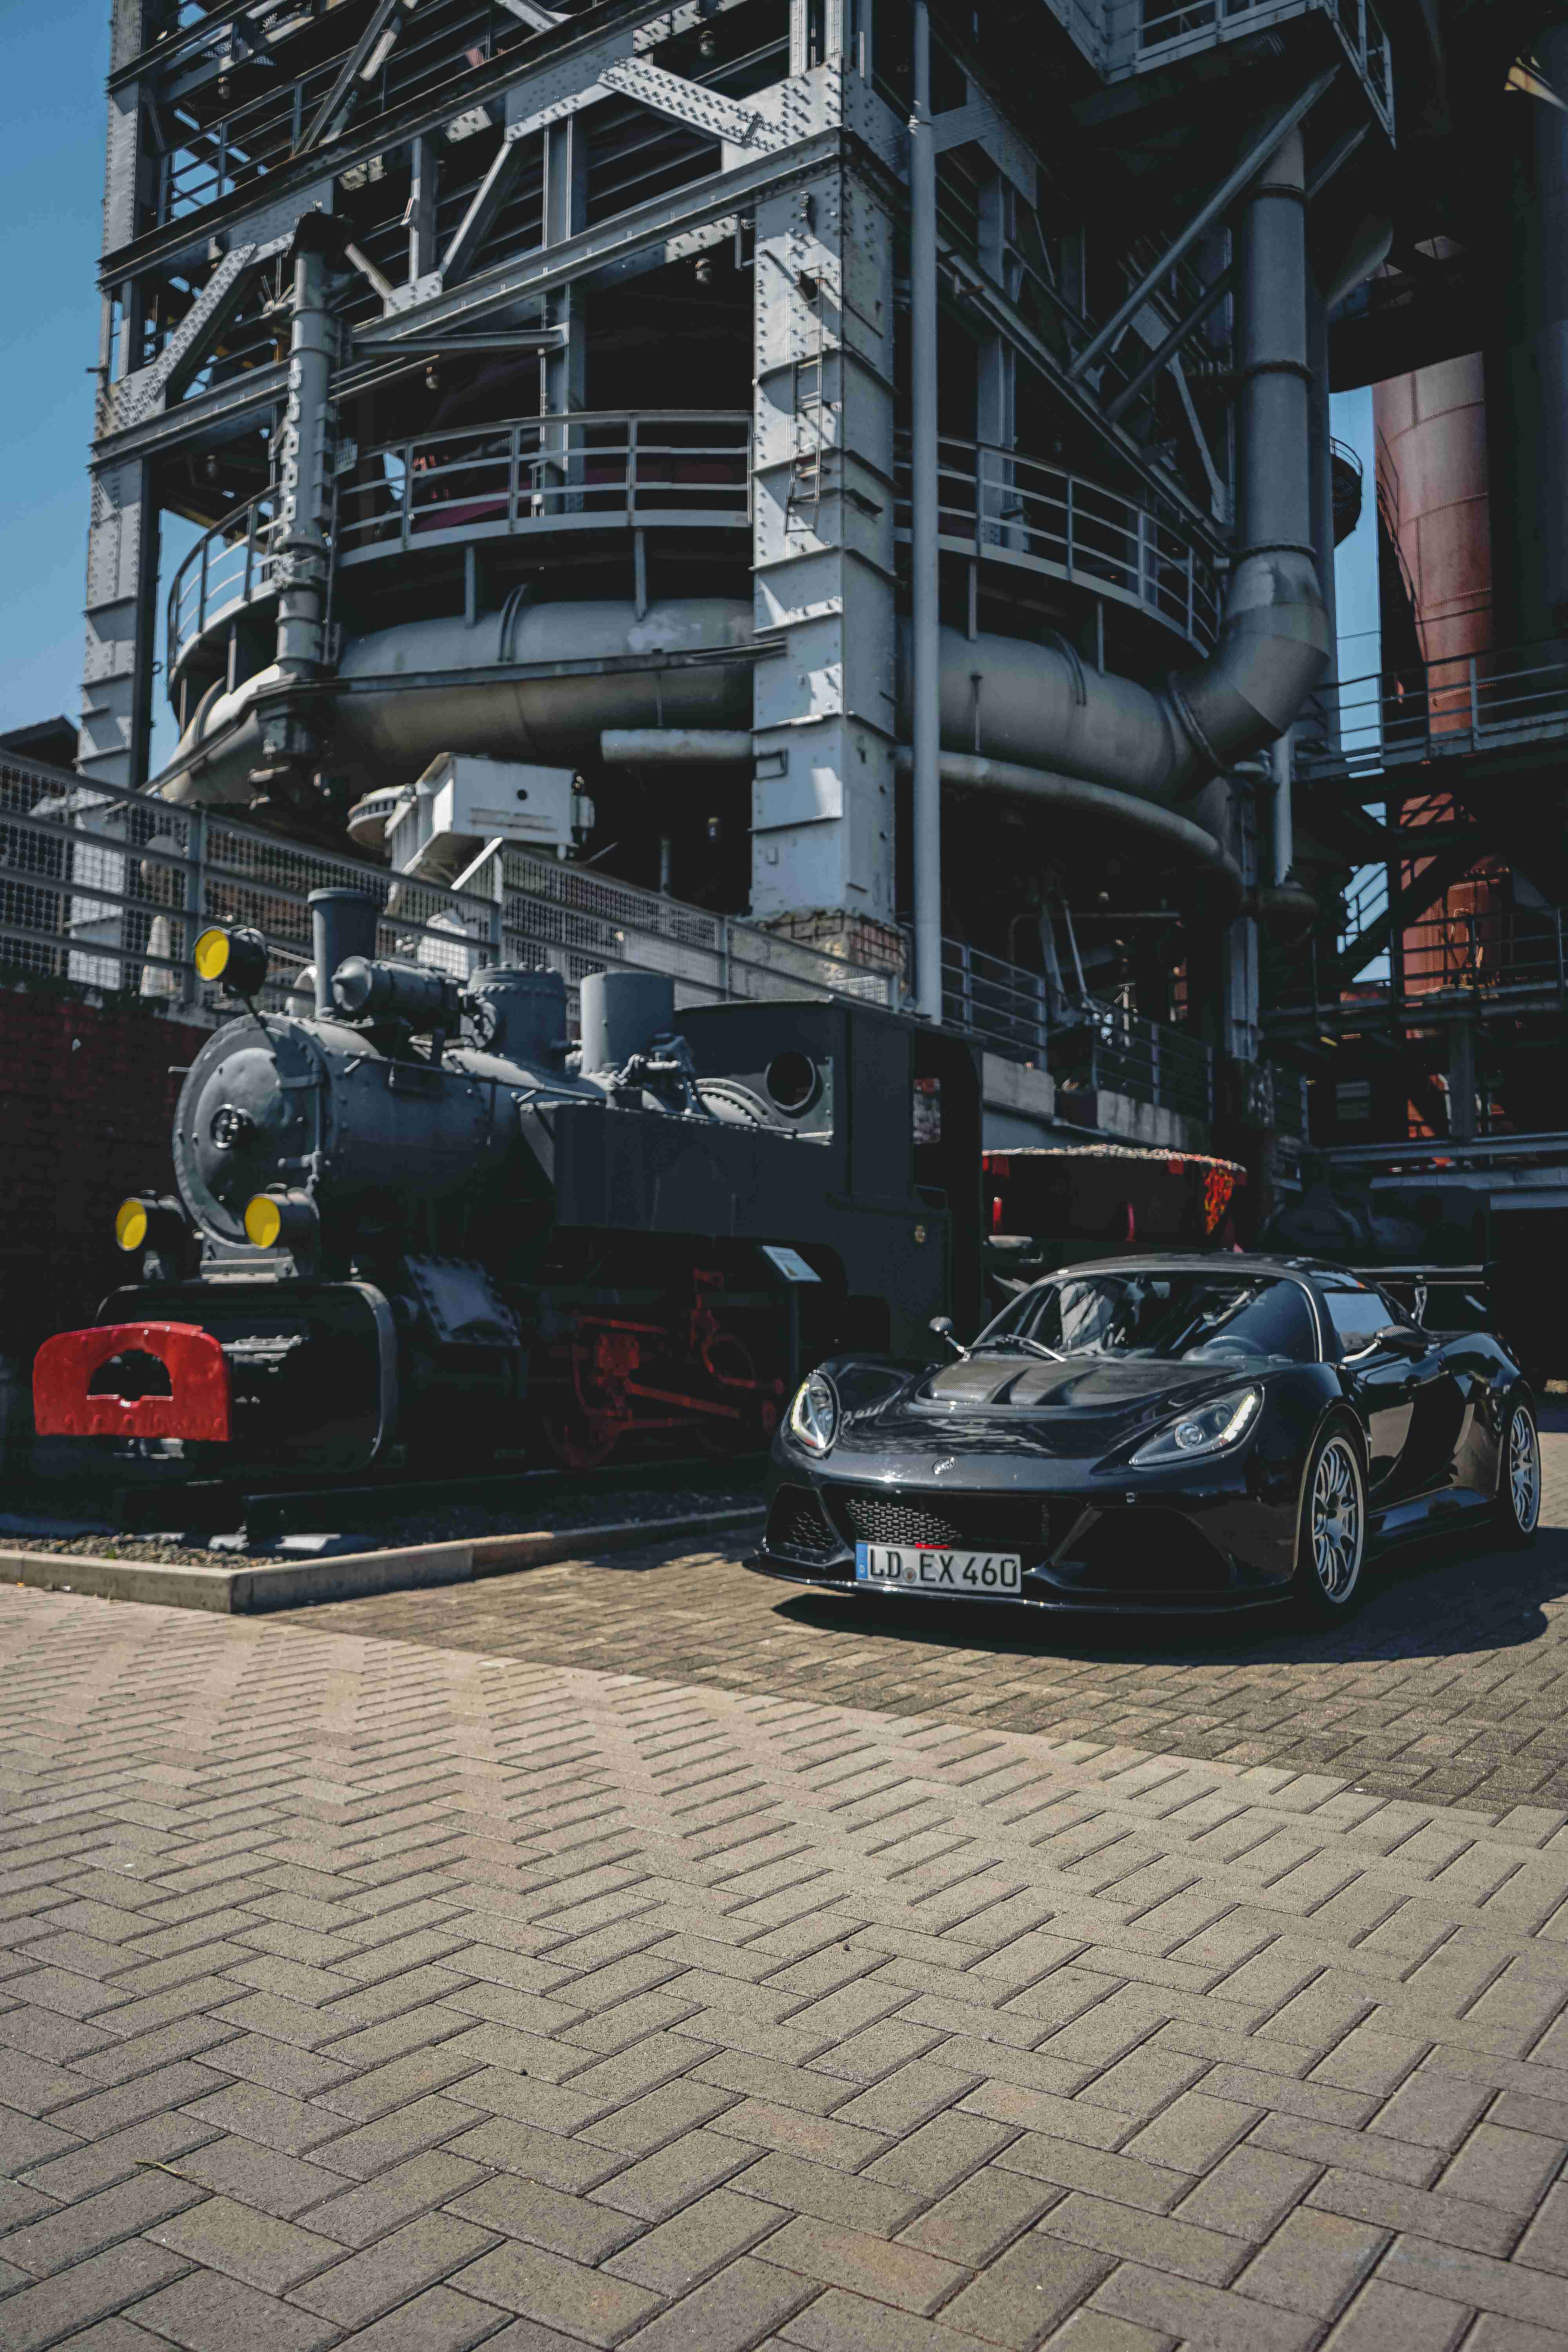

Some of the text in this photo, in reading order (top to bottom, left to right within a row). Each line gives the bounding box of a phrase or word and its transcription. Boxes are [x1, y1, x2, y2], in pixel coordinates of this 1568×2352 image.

[859, 1564, 865, 1575] D
[870, 1549, 1017, 1587] LD EX 460
